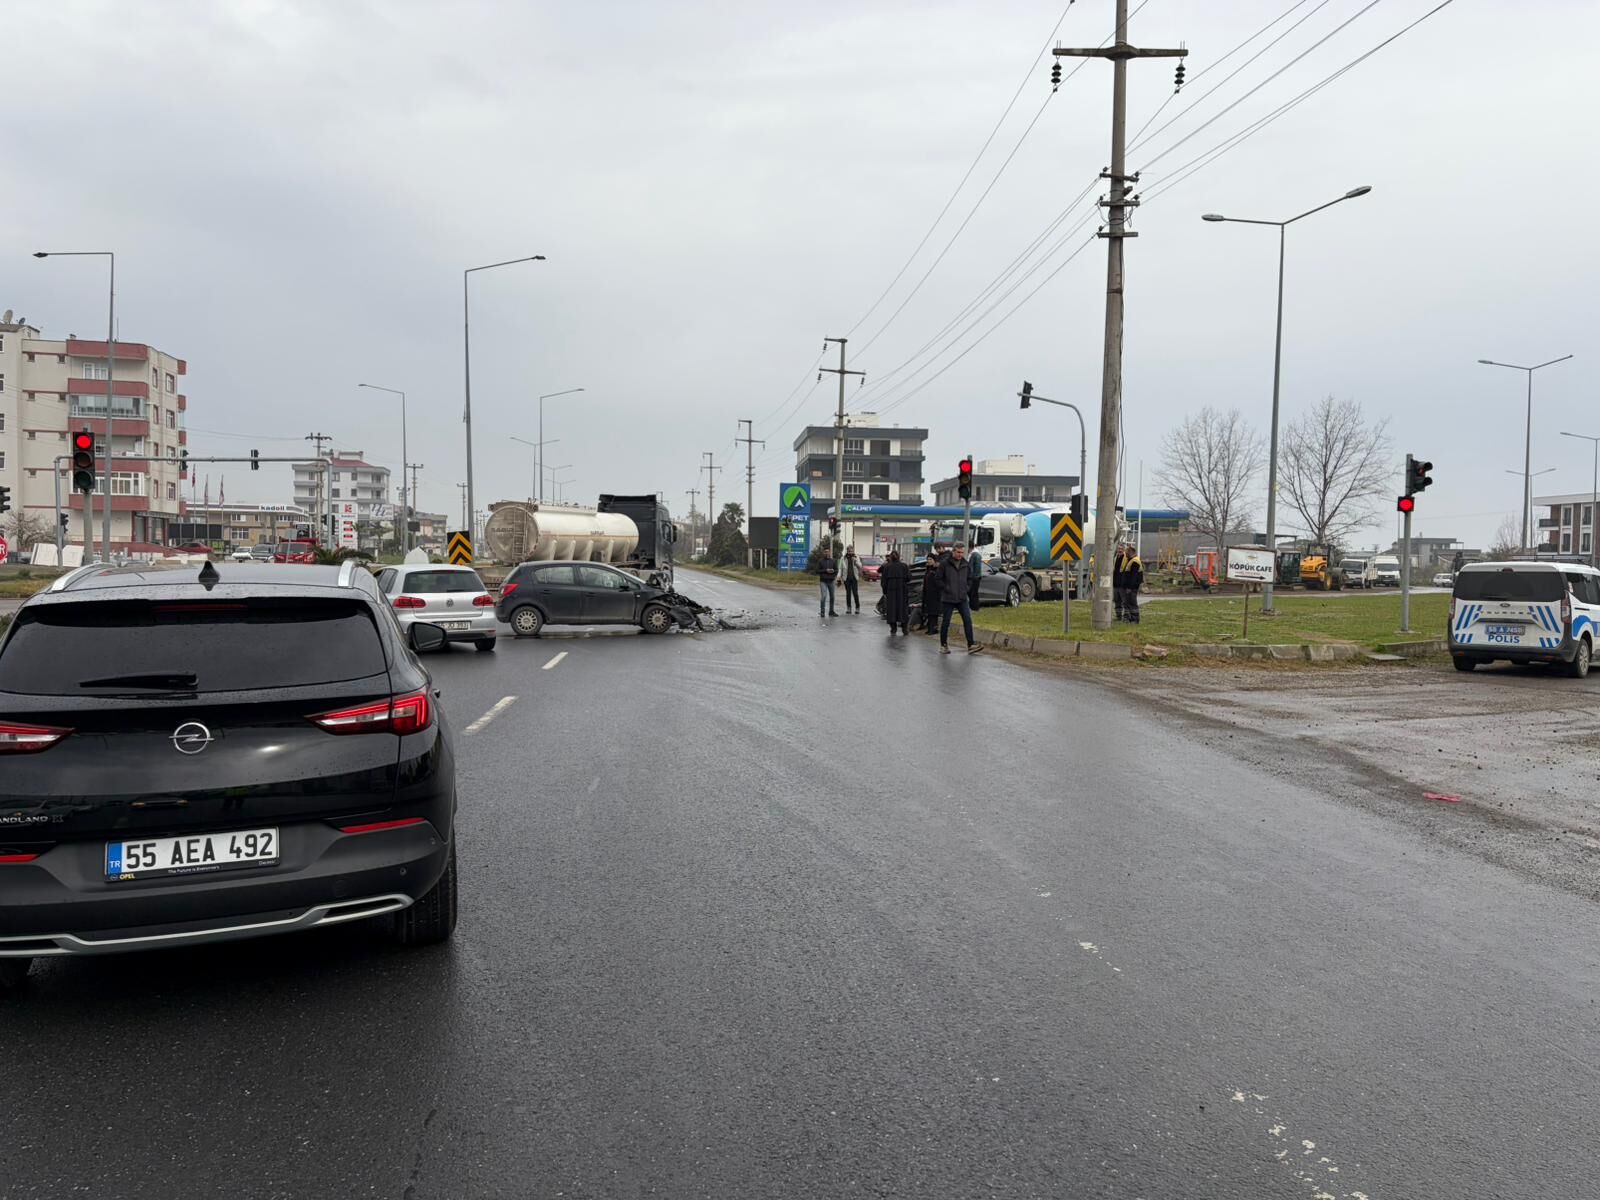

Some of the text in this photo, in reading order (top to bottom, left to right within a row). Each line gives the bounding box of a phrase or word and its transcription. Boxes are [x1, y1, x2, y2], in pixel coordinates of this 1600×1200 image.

[1229, 562, 1272, 573] KÖPÜK CAFE
[126, 832, 273, 869] 55 AEA 492
[109, 860, 121, 868] TR
